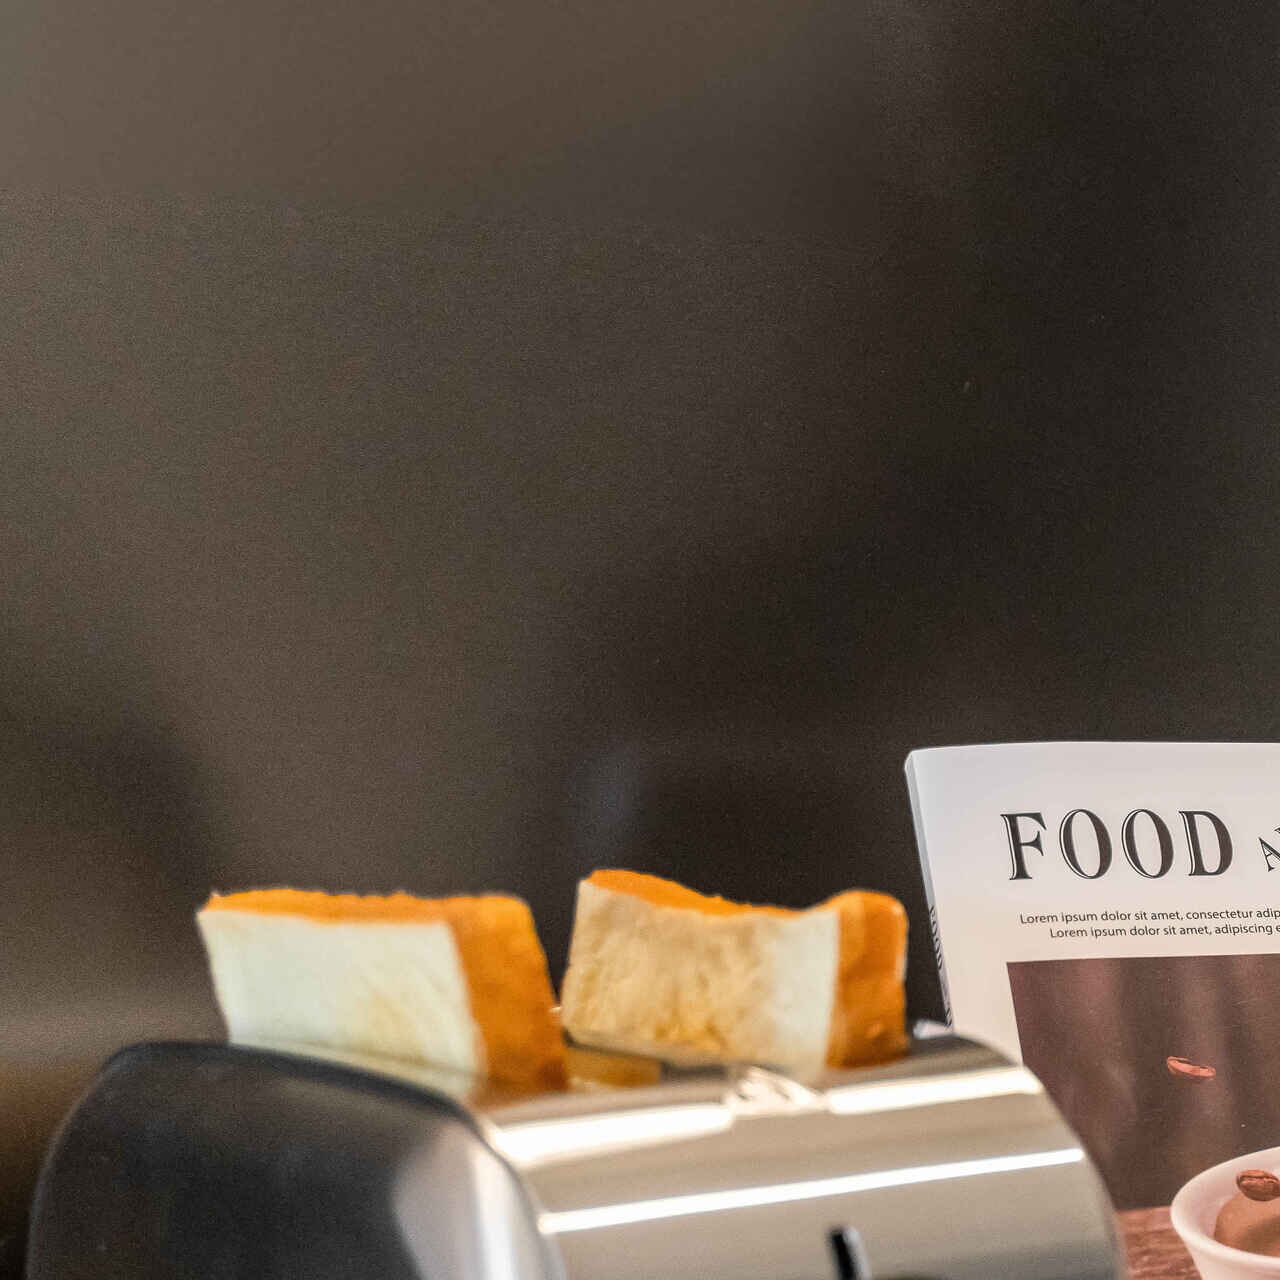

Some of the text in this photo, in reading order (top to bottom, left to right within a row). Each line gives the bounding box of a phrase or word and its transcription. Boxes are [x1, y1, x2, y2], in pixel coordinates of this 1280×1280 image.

[1000, 807, 1234, 882] FOOD
[1020, 912, 1058, 924] Lorem
[1061, 911, 1098, 924] ipsum
[1101, 909, 1132, 921] dolor
[1135, 909, 1148, 921] sit
[1151, 909, 1184, 921] amet,
[1186, 907, 1254, 920] consectetur
[1049, 927, 1088, 939] Lorem
[1090, 926, 1127, 939] ipsum
[1129, 925, 1160, 937] dolor
[1163, 925, 1177, 936] sit
[1179, 925, 1213, 937] amet,
[1214, 922, 1273, 937] adipiscing
